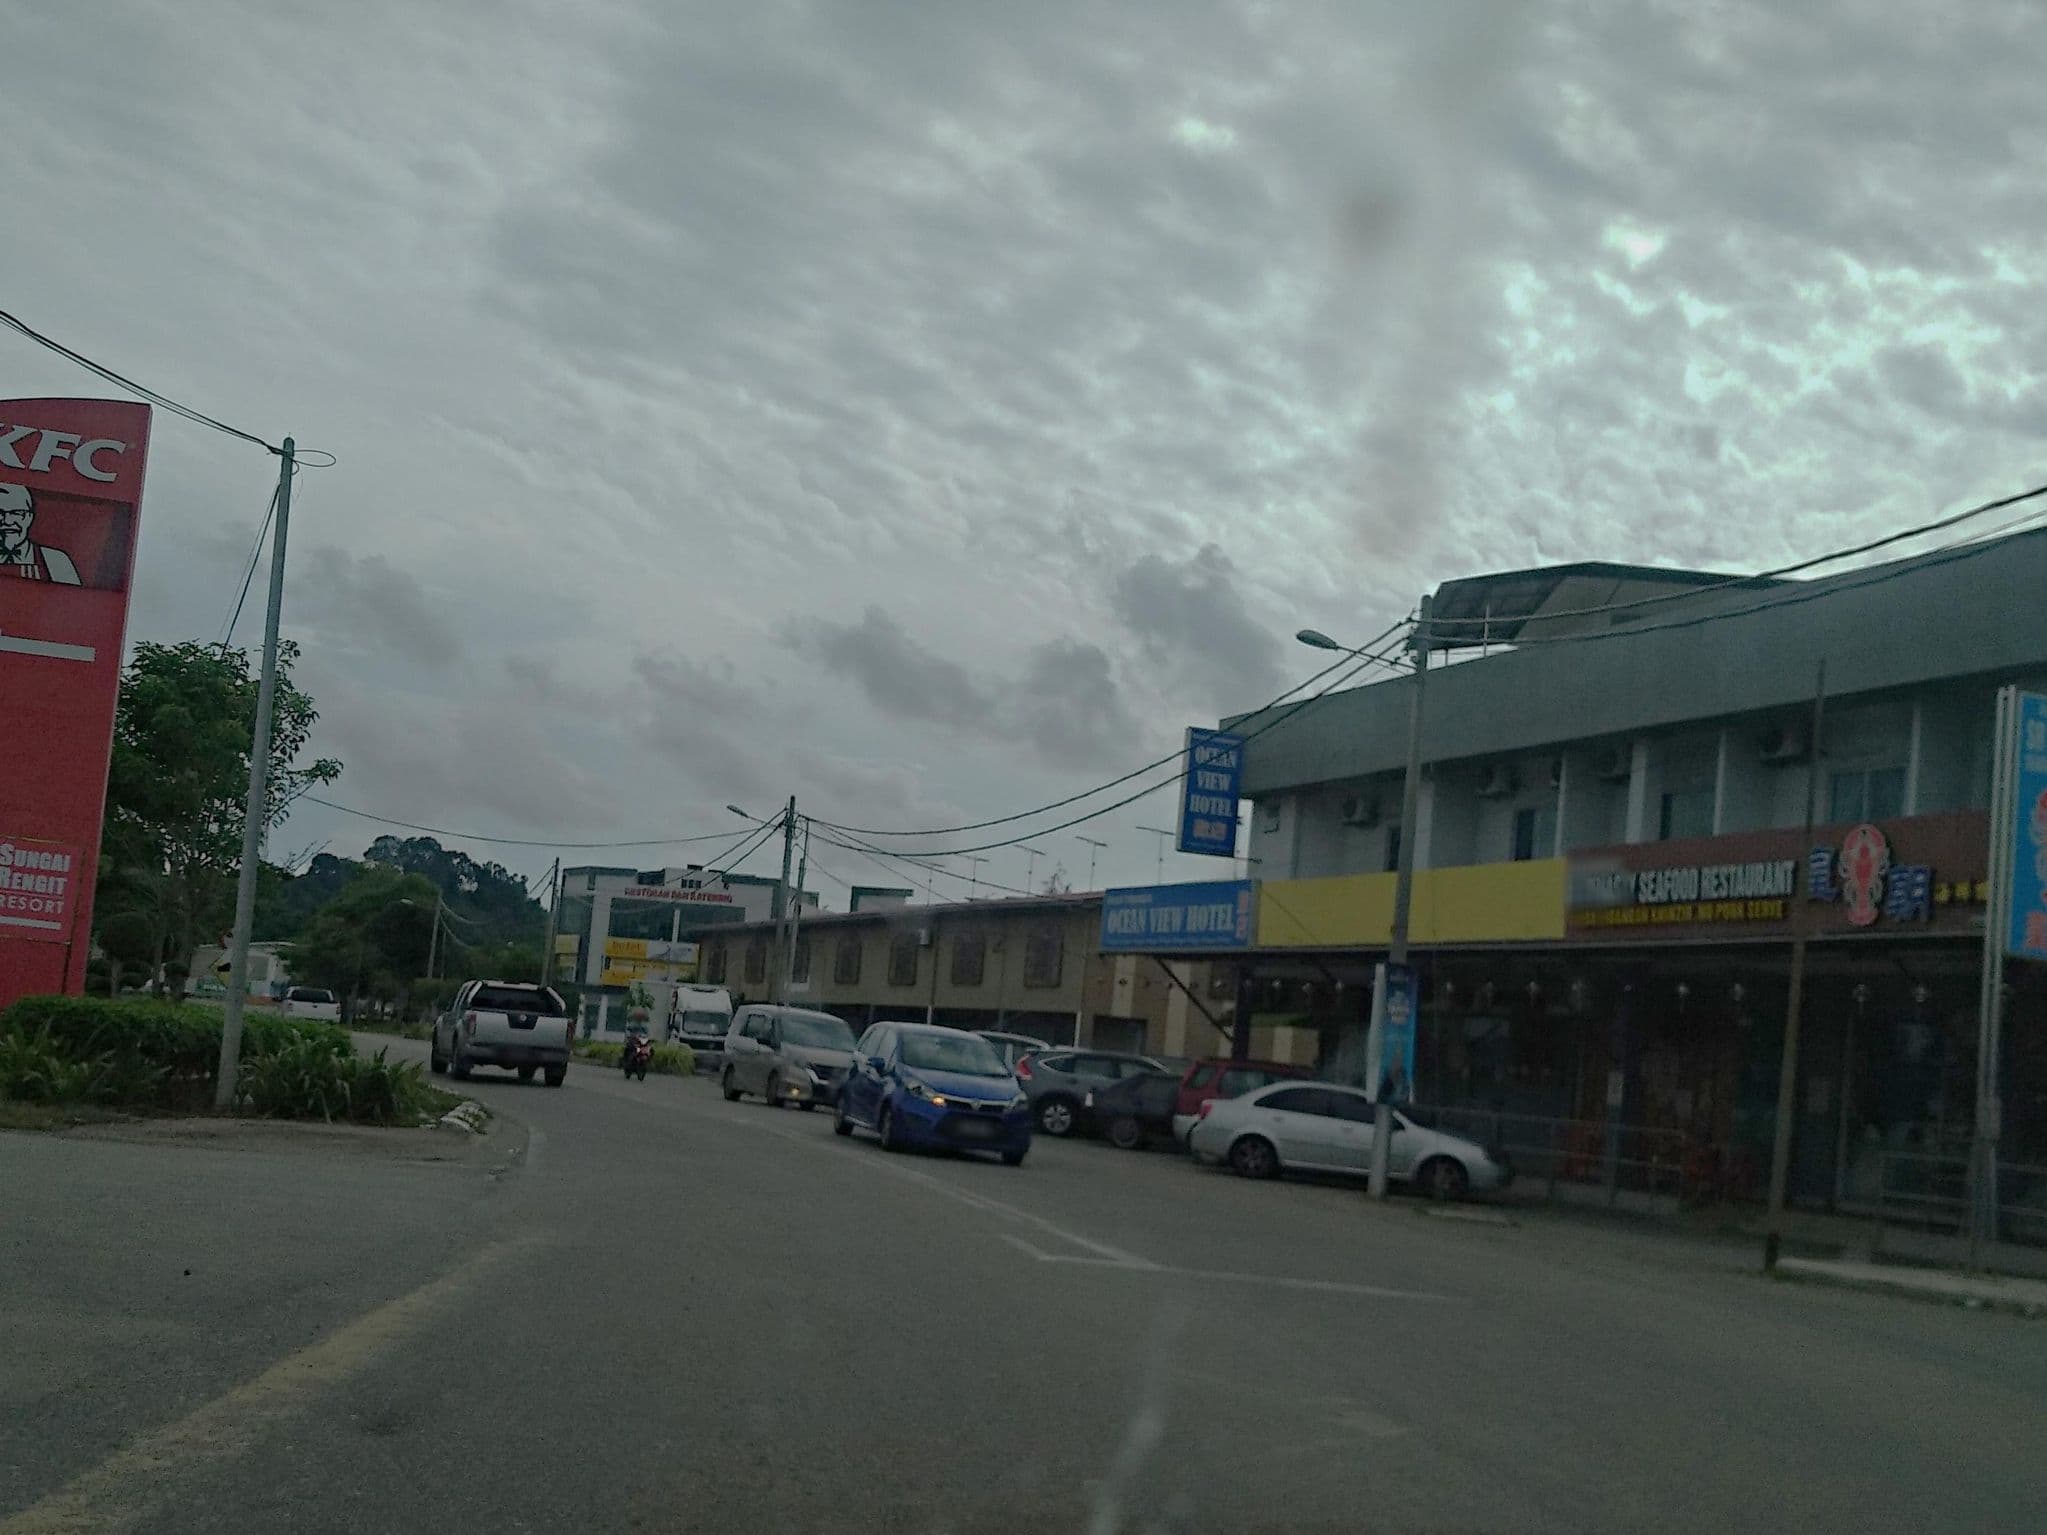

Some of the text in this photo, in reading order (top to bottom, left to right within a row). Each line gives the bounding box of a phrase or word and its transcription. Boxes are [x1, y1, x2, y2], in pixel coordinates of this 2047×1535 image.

[0, 422, 127, 482] KFC
[1197, 770, 1232, 791] VIEW
[1189, 794, 1232, 817] HOTEL
[1638, 867, 1698, 904] SEAFOOD
[1700, 860, 1796, 900] RESTAURANT
[1107, 908, 1146, 934] OCEAN
[1149, 906, 1184, 933] VIEW
[1186, 904, 1234, 931] HOTEL
